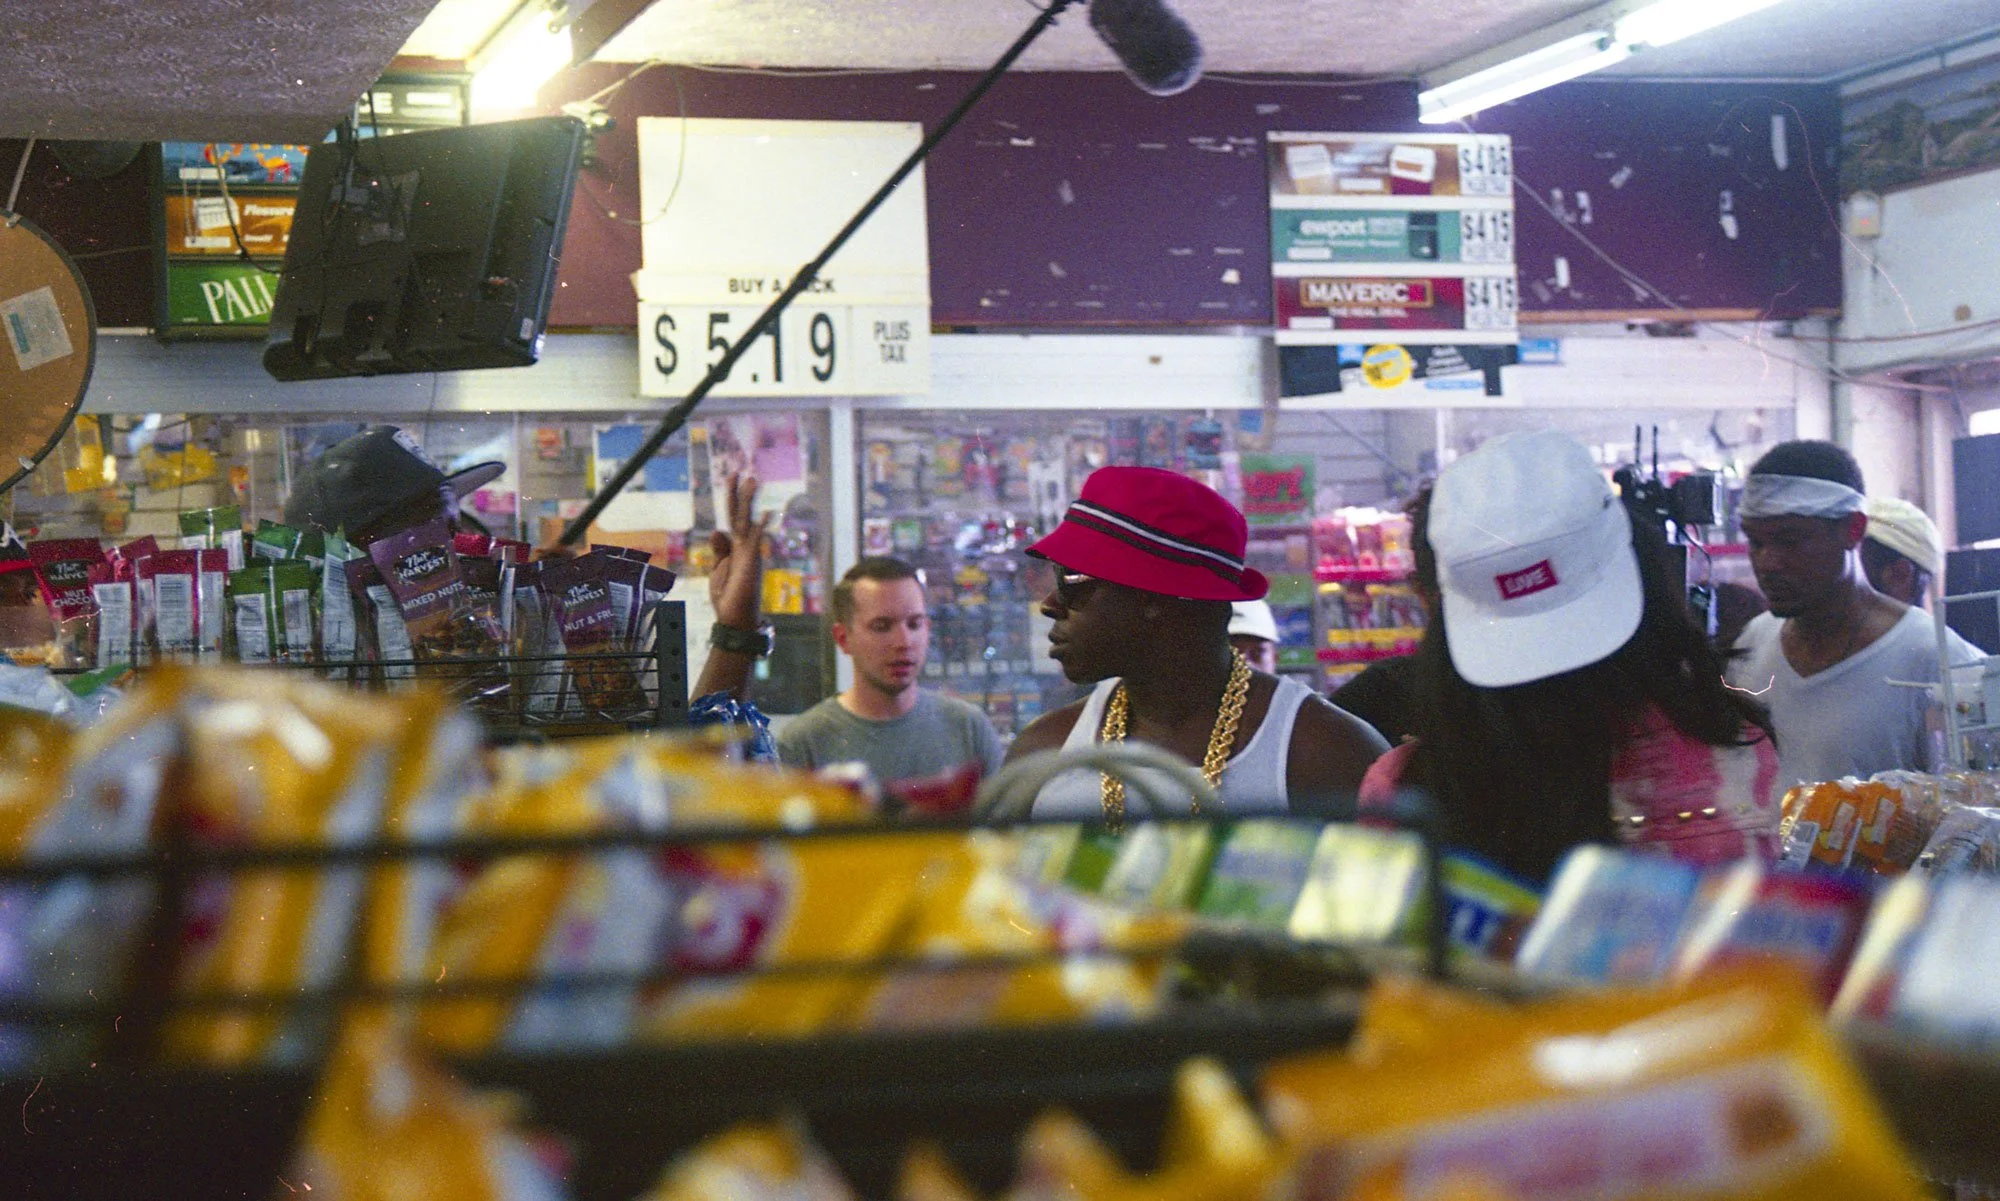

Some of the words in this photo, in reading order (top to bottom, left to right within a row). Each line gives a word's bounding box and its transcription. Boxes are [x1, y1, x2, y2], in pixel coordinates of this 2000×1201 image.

[729, 278, 764, 293] BUY
[772, 278, 782, 293] A
[873, 321, 911, 341] PLUS
[880, 345, 906, 363] TAX
[50, 570, 89, 581] HARVES
[398, 556, 445, 579] HARVEST
[52, 596, 95, 609] CHOCO
[401, 592, 437, 612] MIXED
[437, 580, 466, 599] NUTS
[563, 588, 606, 608] HARVEST
[563, 618, 586, 632] NUT
[587, 615, 597, 626] &
